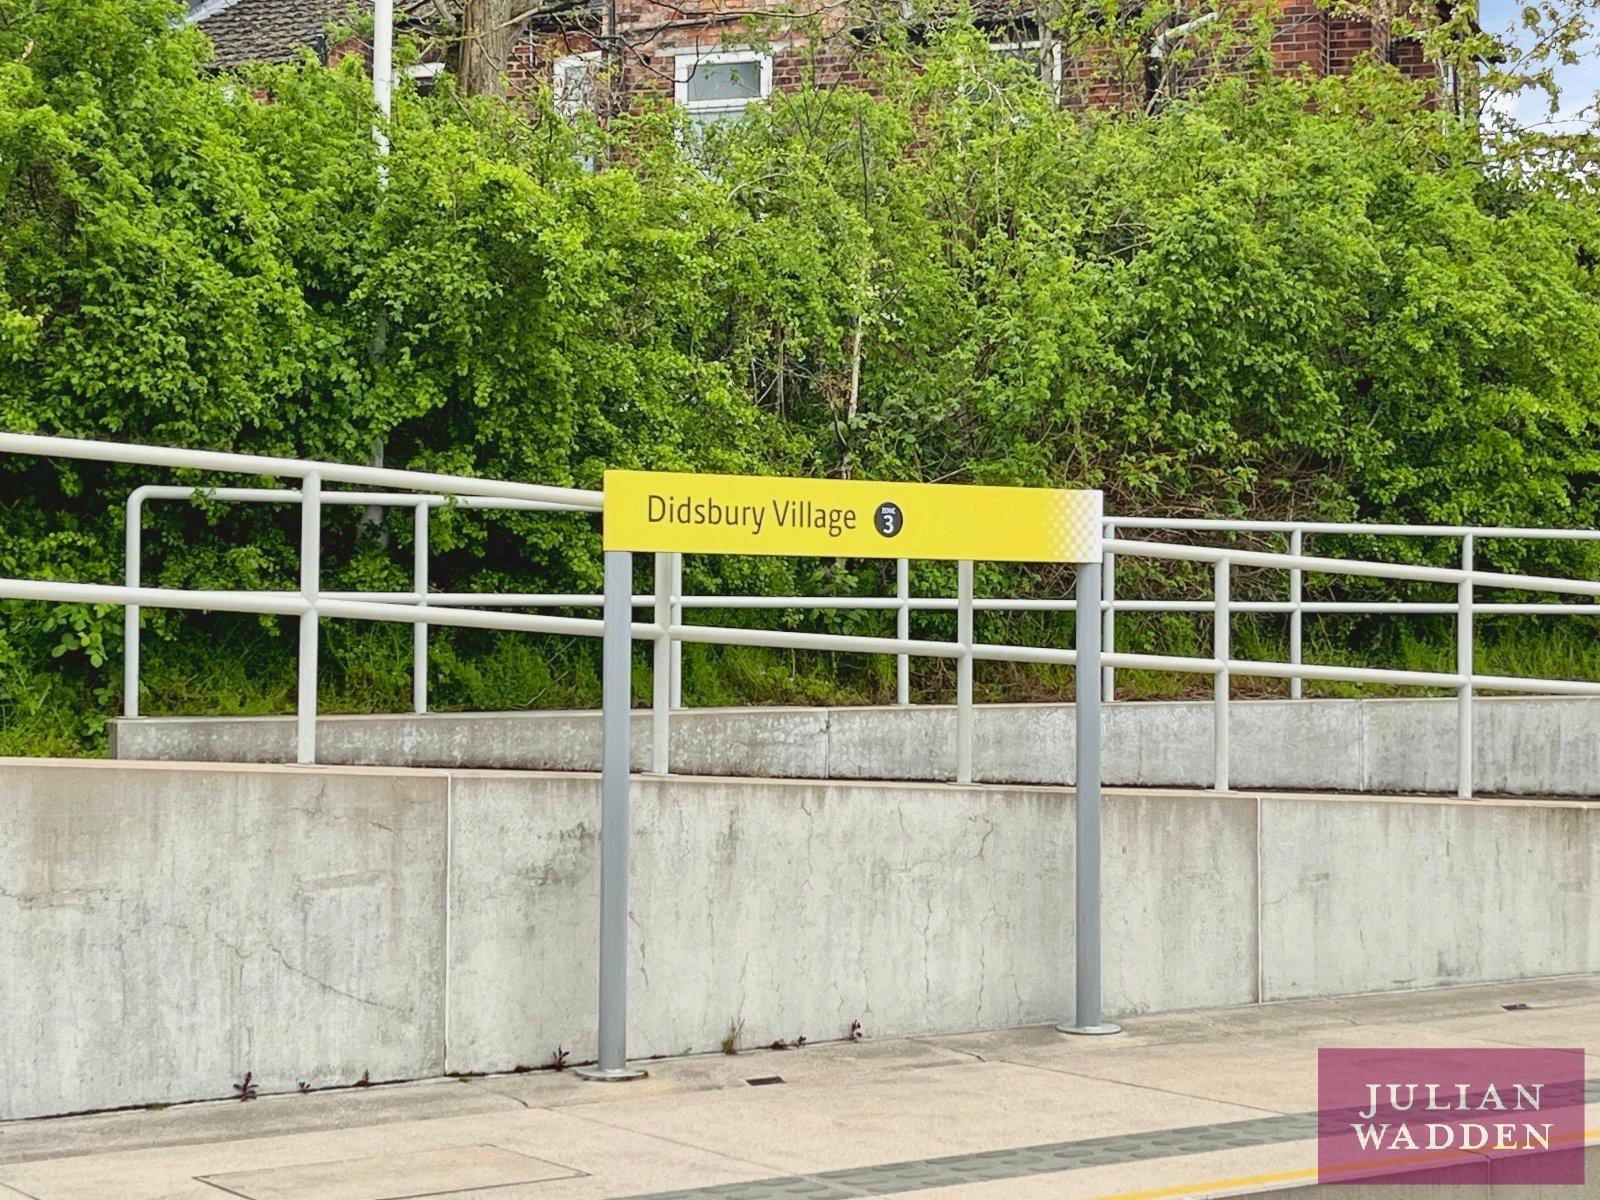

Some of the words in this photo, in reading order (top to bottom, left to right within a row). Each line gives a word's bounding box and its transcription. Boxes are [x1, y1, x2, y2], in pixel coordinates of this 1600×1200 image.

[648, 494, 766, 534] Didsbury
[772, 499, 857, 537] Village
[882, 514, 895, 534] 3
